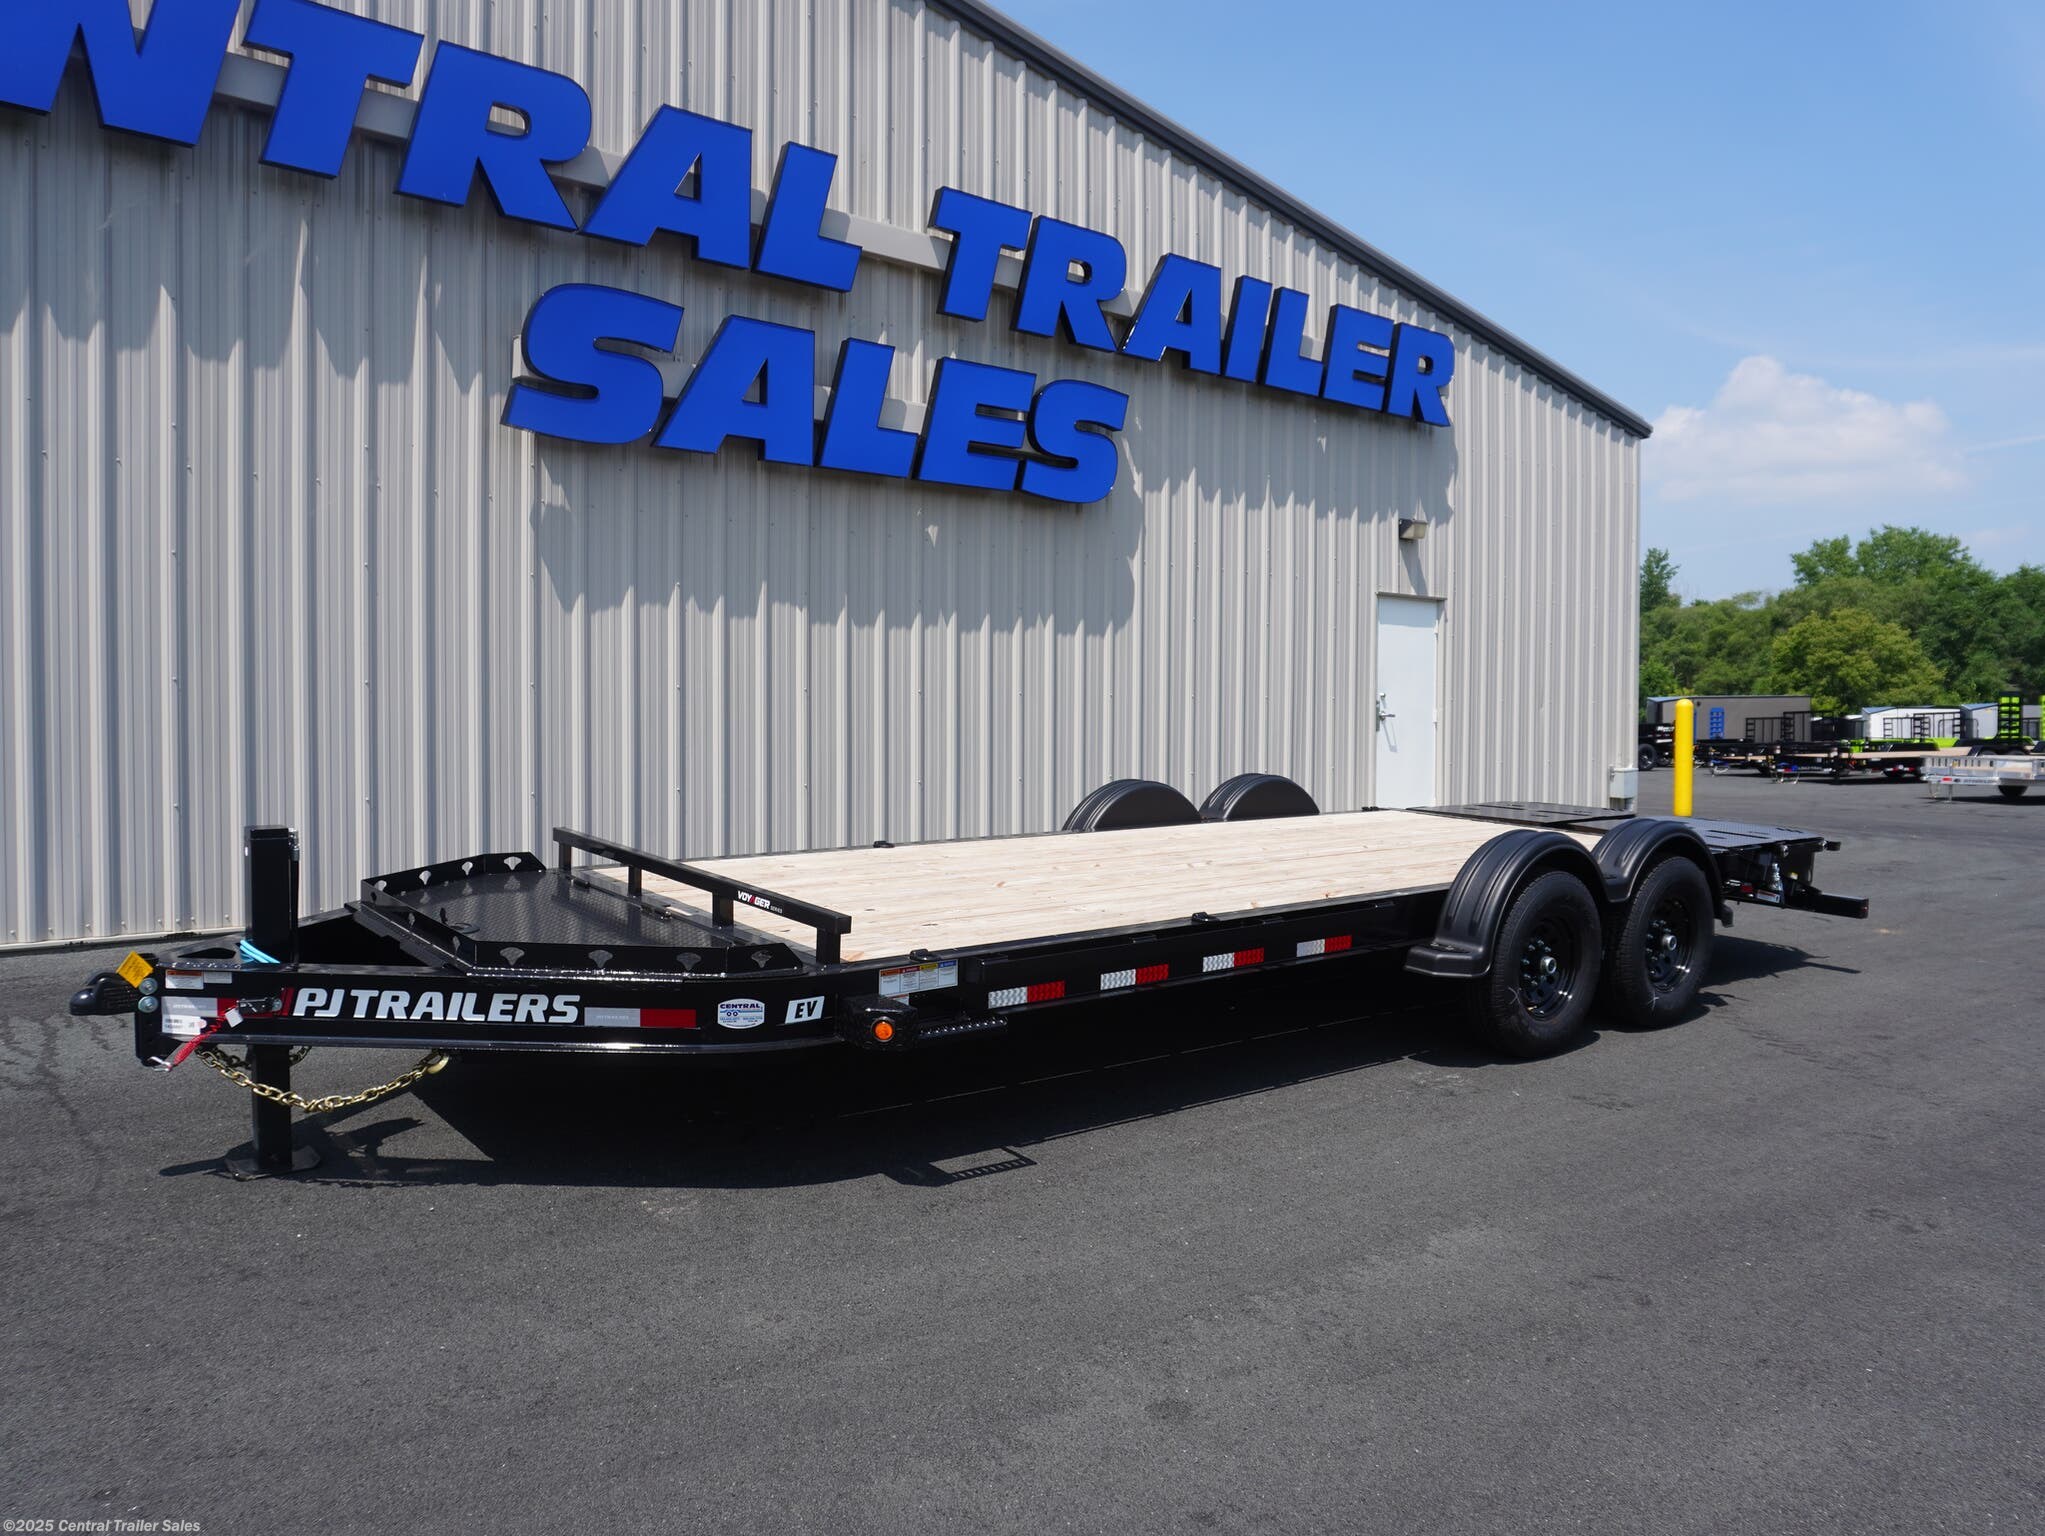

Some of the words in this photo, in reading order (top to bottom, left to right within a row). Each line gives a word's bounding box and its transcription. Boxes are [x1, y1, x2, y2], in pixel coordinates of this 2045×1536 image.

[930, 186, 1455, 428] TRAILER
[502, 284, 1129, 505] SALES
[292, 987, 346, 1017] PJ
[350, 989, 581, 1024] TRAILERS
[794, 1000, 818, 1020] EV
